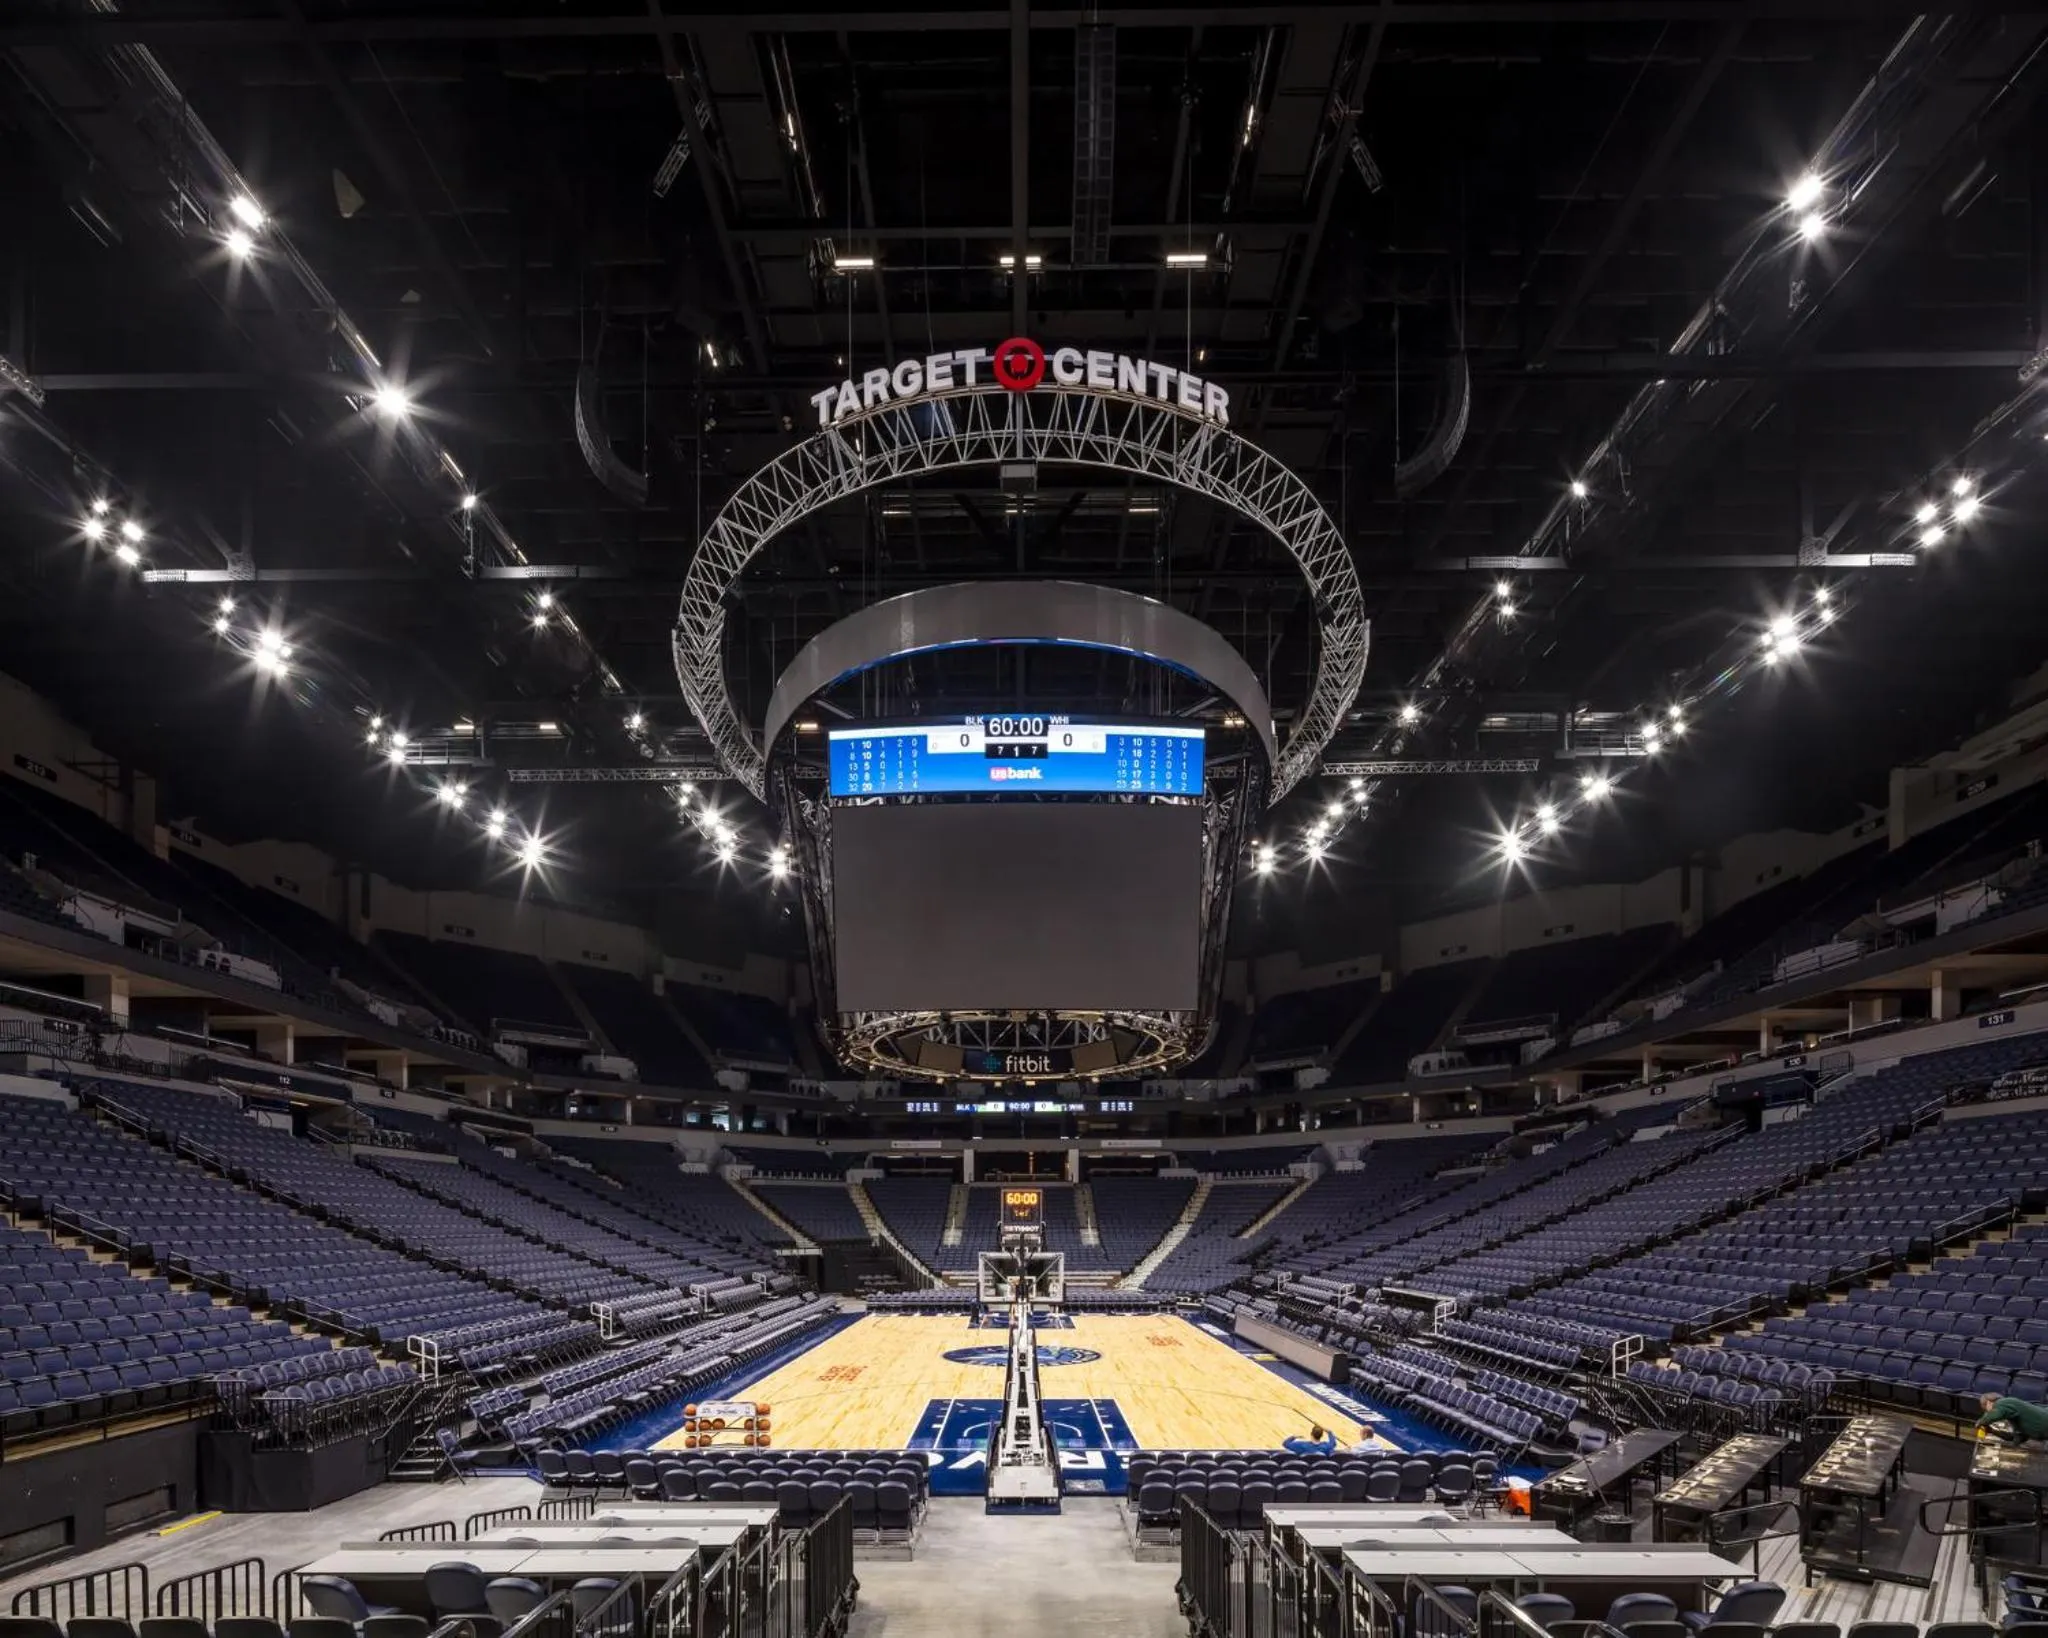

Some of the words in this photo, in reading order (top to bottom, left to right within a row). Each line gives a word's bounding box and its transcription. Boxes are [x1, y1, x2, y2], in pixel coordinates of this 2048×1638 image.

[811, 347, 987, 426] TARGET
[1052, 347, 1230, 426] CENTER
[965, 716, 984, 725] BLK
[1050, 715, 1069, 725] WHI
[989, 717, 1043, 735] 60:00
[862, 740, 872, 749] 10
[912, 738, 918, 747] 0
[960, 734, 970, 747] 0
[1063, 733, 1073, 747] 0
[1132, 738, 1142, 747] 10
[1166, 739, 1172, 748] 0
[1182, 740, 1188, 749] 0
[862, 751, 872, 760] 10
[997, 745, 1004, 755] 7
[1013, 745, 1019, 757] 1
[1031, 745, 1038, 755] 7
[1150, 750, 1156, 758] 2
[1118, 759, 1127, 768] 10
[1134, 759, 1140, 768] 0
[1166, 760, 1172, 770] 0
[1987, 1013, 2004, 1025] 131
[1005, 1056, 1050, 1073] fitbit
[279, 1075, 291, 1085] 112
[1006, 1192, 1038, 1205] 60:00
